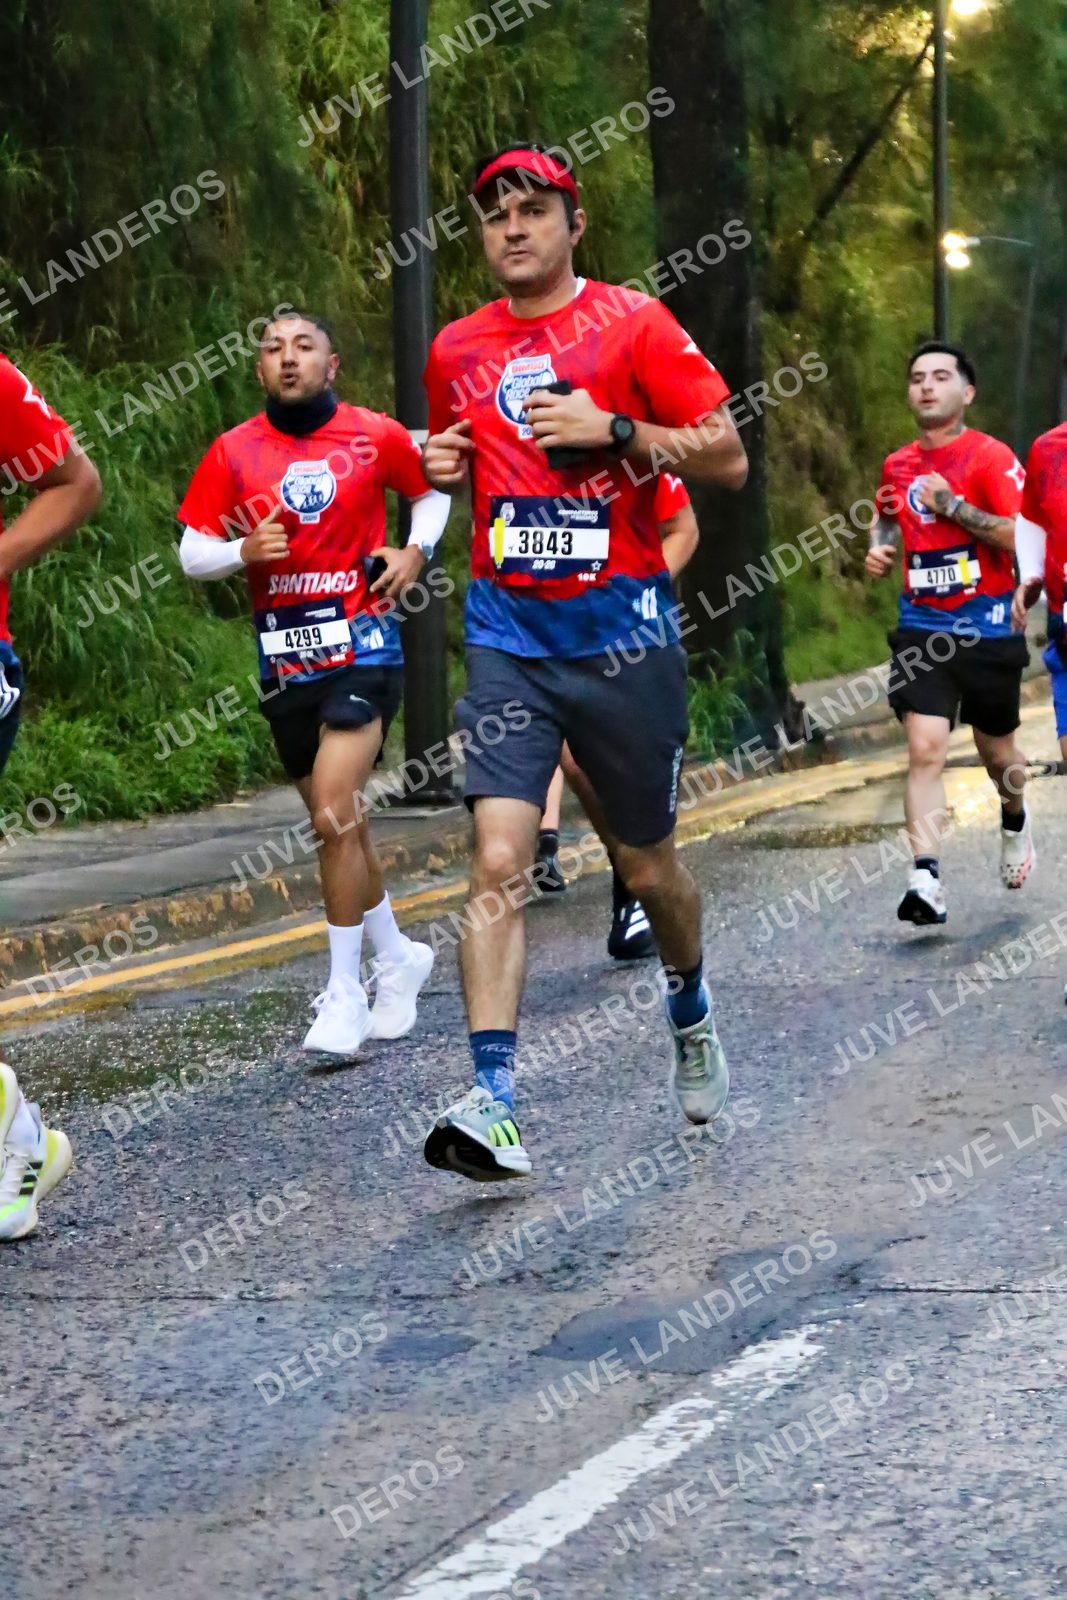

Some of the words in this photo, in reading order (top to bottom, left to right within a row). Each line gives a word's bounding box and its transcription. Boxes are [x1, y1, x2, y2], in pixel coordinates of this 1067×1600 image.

[518, 530, 573, 555] 3843
[268, 570, 358, 595] SANTIAGO
[926, 566, 956, 585] 4770
[285, 626, 323, 649] 4299
